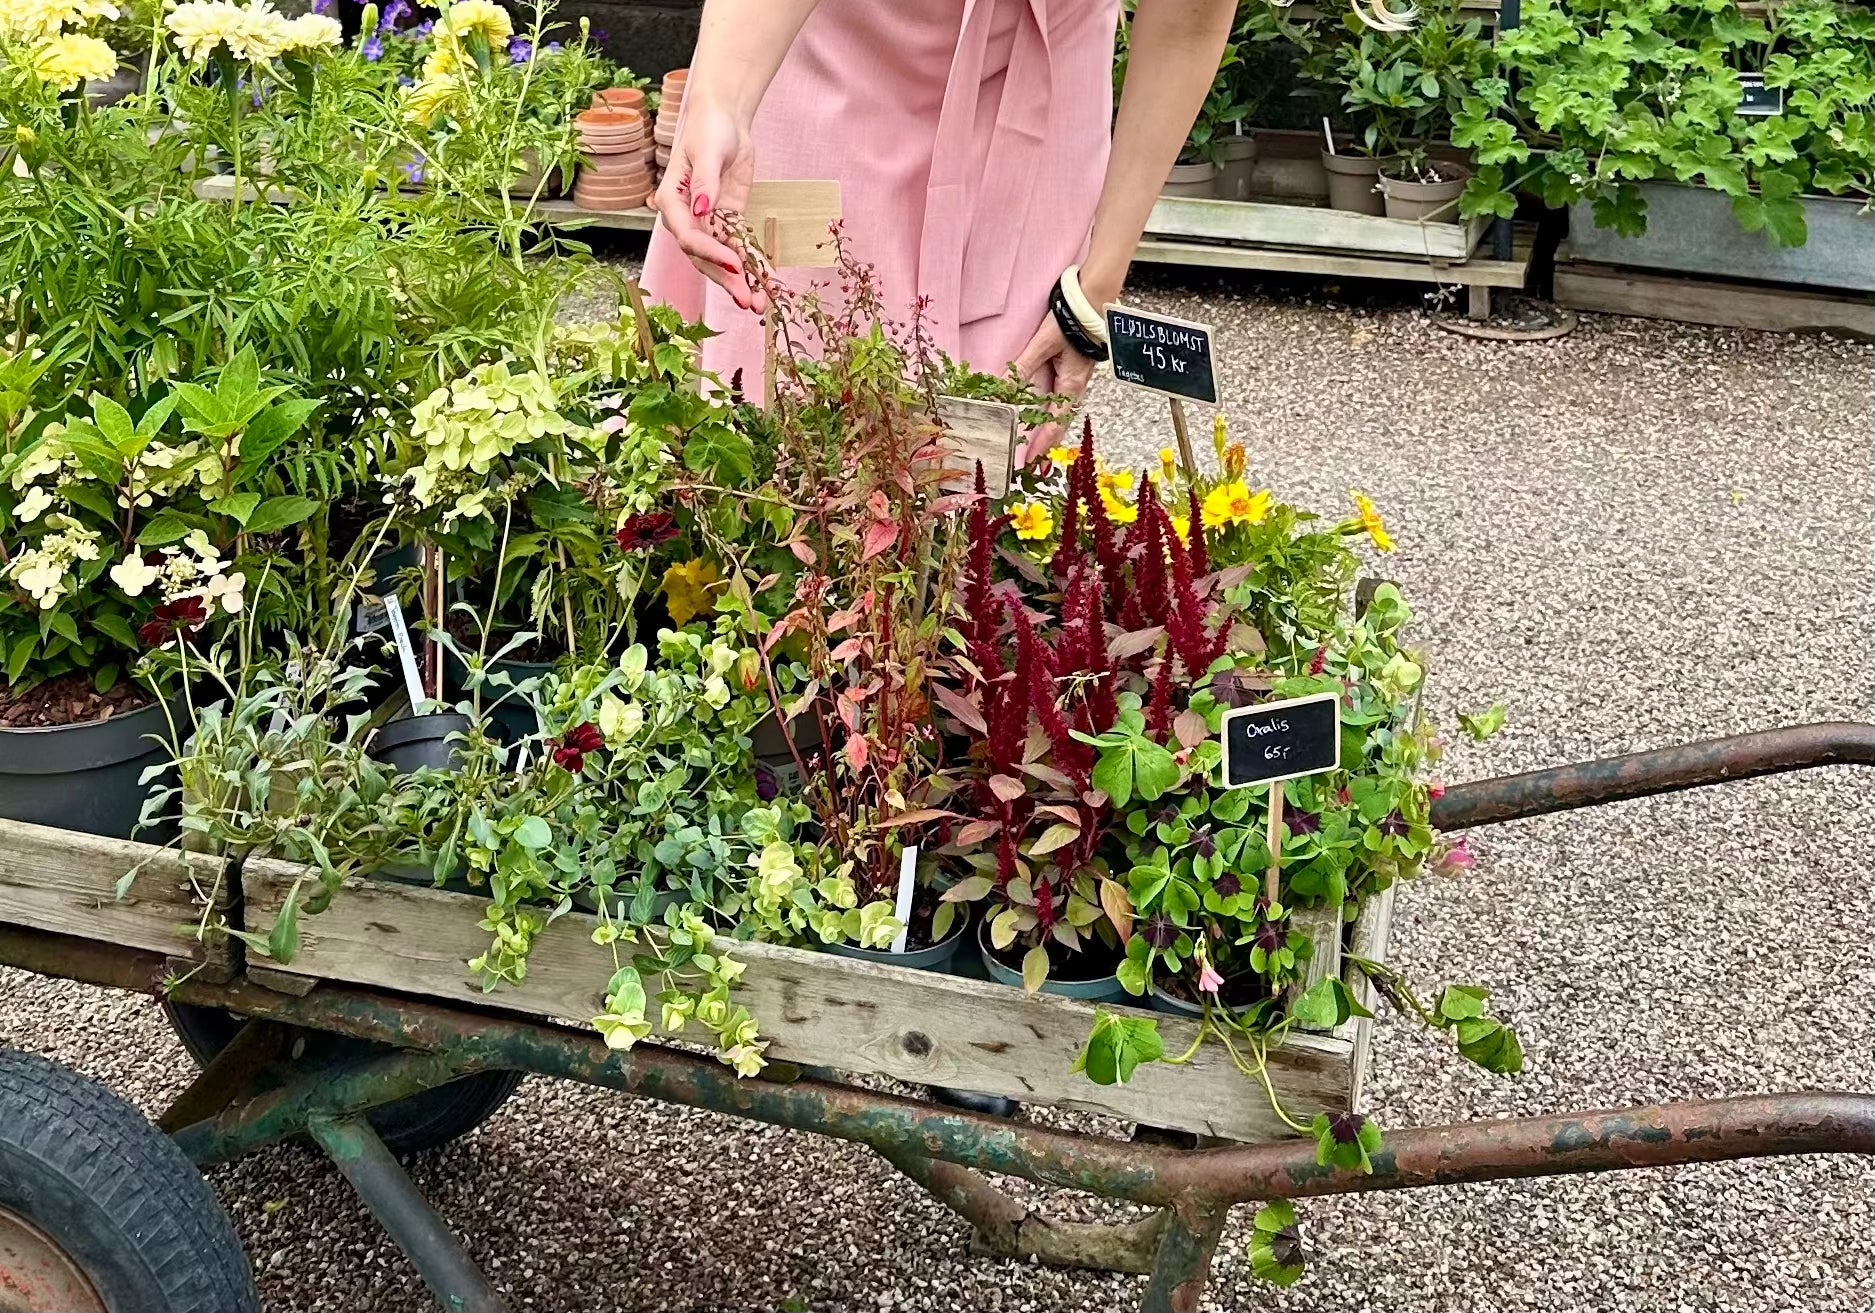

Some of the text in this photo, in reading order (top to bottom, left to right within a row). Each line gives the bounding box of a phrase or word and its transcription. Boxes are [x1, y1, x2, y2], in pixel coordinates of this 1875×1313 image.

[1113, 316, 1205, 353] FLØJLSBLOMST
[1142, 343, 1166, 370] 45
[1246, 717, 1290, 738] Oxalis
